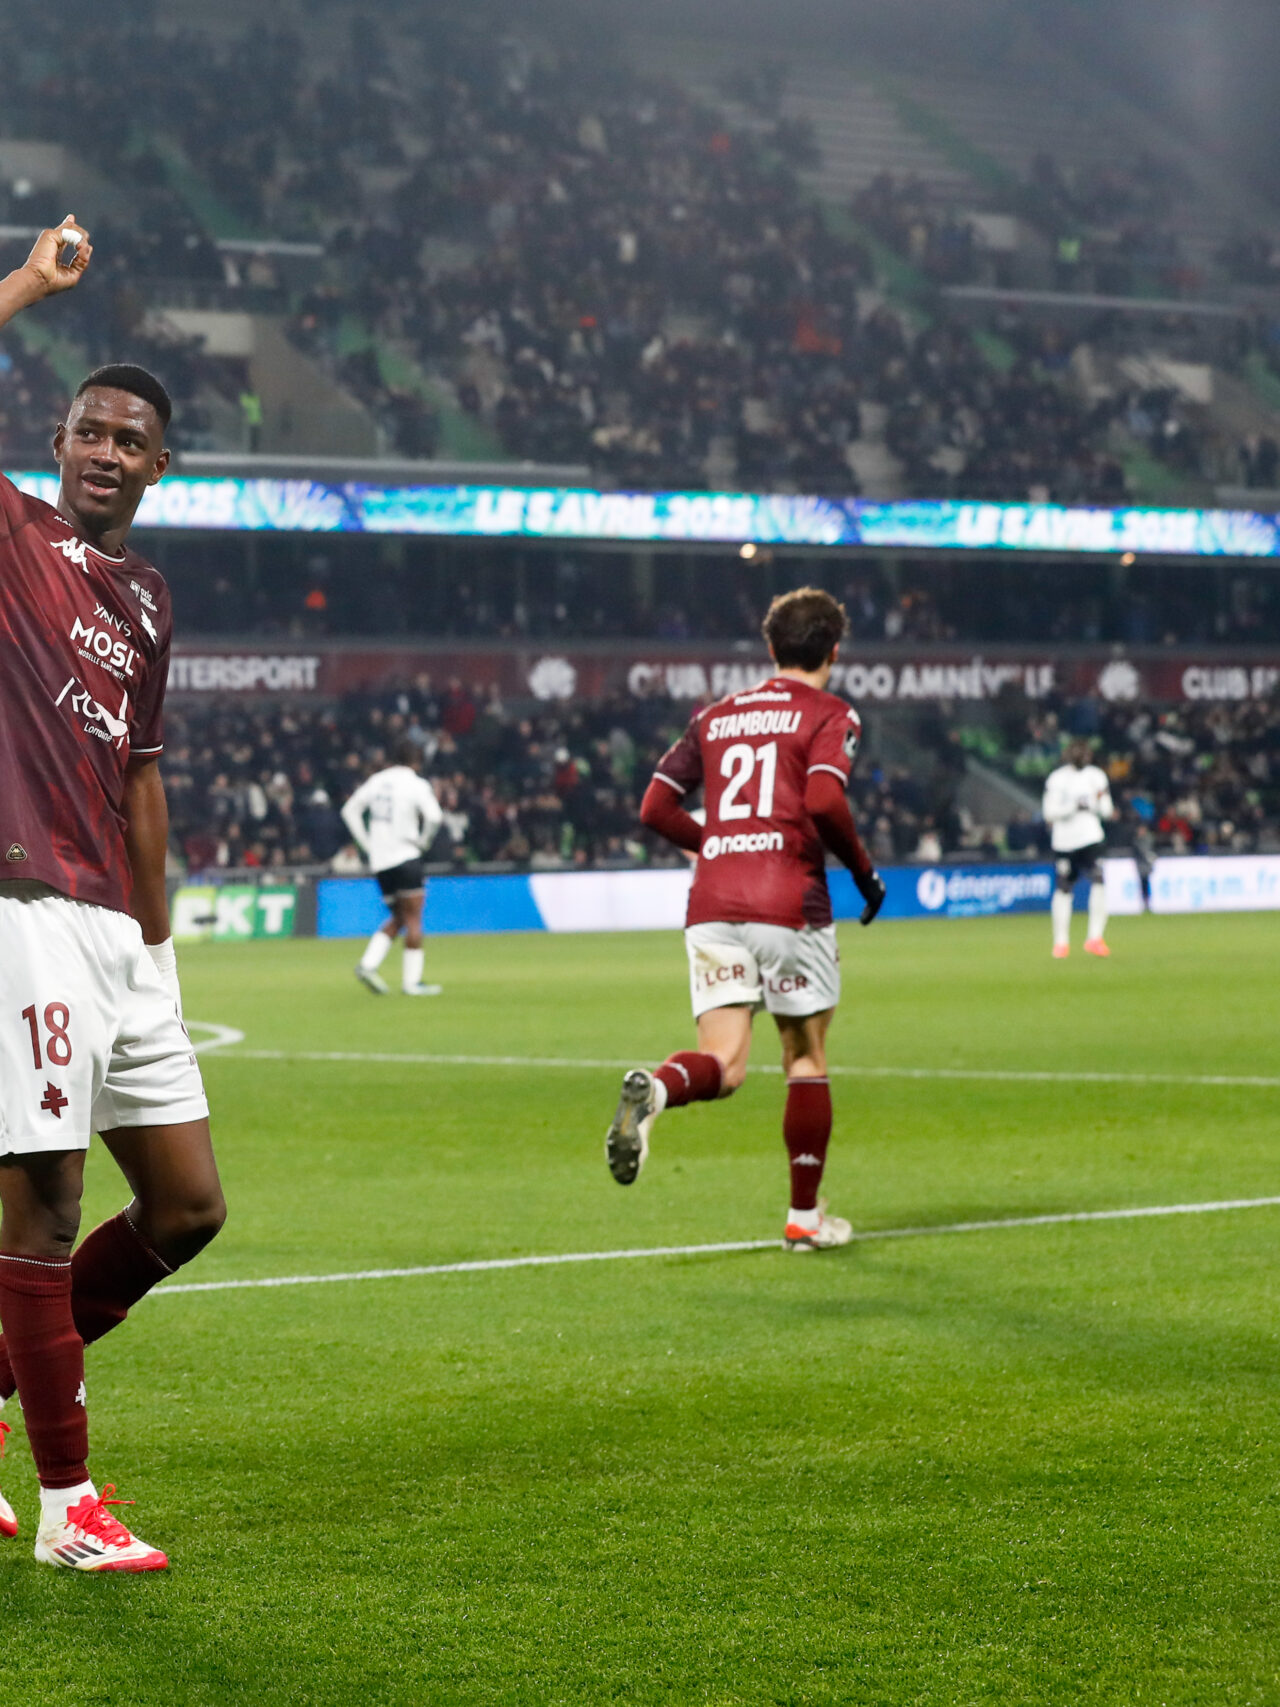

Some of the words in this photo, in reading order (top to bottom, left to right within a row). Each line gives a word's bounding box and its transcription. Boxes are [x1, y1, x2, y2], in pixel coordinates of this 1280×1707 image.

[665, 494, 754, 540] 2025
[167, 655, 320, 691] TERSPORT
[84, 721, 113, 743] Lorraine
[706, 710, 802, 742] STAMBOULI
[718, 741, 778, 821] 21
[704, 963, 746, 987] LCR
[768, 974, 808, 995] LCR
[22, 1001, 73, 1070] 18
